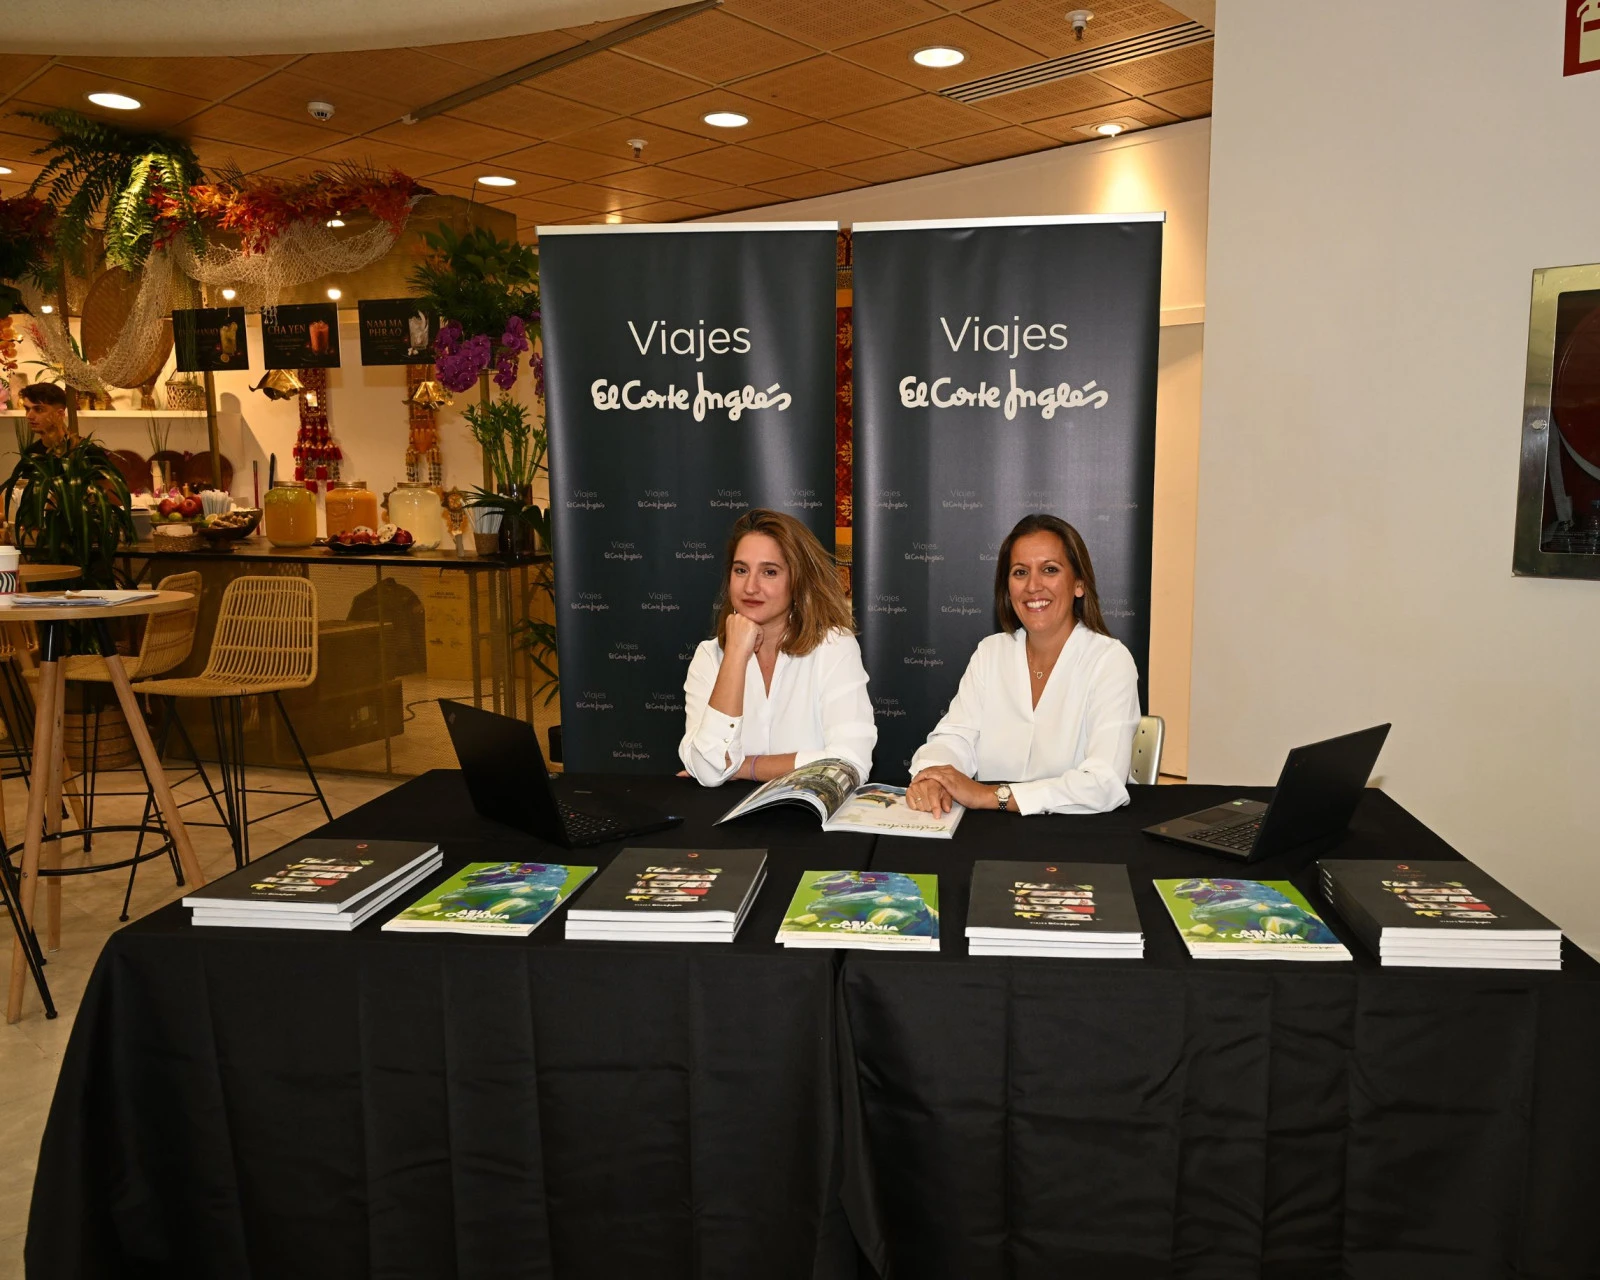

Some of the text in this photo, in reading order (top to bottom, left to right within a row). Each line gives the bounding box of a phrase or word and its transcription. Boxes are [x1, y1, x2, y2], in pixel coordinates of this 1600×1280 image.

[366, 319, 404, 328] NAM MA
[268, 324, 306, 335] CHA YEN
[368, 328, 402, 337] PHRAO
[628, 320, 751, 362] Viajes
[940, 316, 1068, 360] Viajes
[591, 372, 792, 422] El Corte Inglés
[899, 369, 1108, 420] El Corte Inglés
[574, 490, 598, 498] Viajes
[645, 489, 669, 498] Viajes
[718, 489, 742, 498] Viajes
[792, 488, 815, 497] Viajes
[611, 541, 635, 550] Viajes
[682, 541, 707, 550] Viajes
[578, 592, 602, 601] Viajes
[648, 592, 672, 602] Viajes
[876, 594, 900, 602] Viajes
[616, 642, 639, 650] Viajes
[912, 646, 936, 656] Viajes
[582, 691, 606, 700] Viajes
[652, 692, 676, 701] Viajes
[875, 698, 899, 706] Viajes
[620, 740, 643, 750] Viajes
